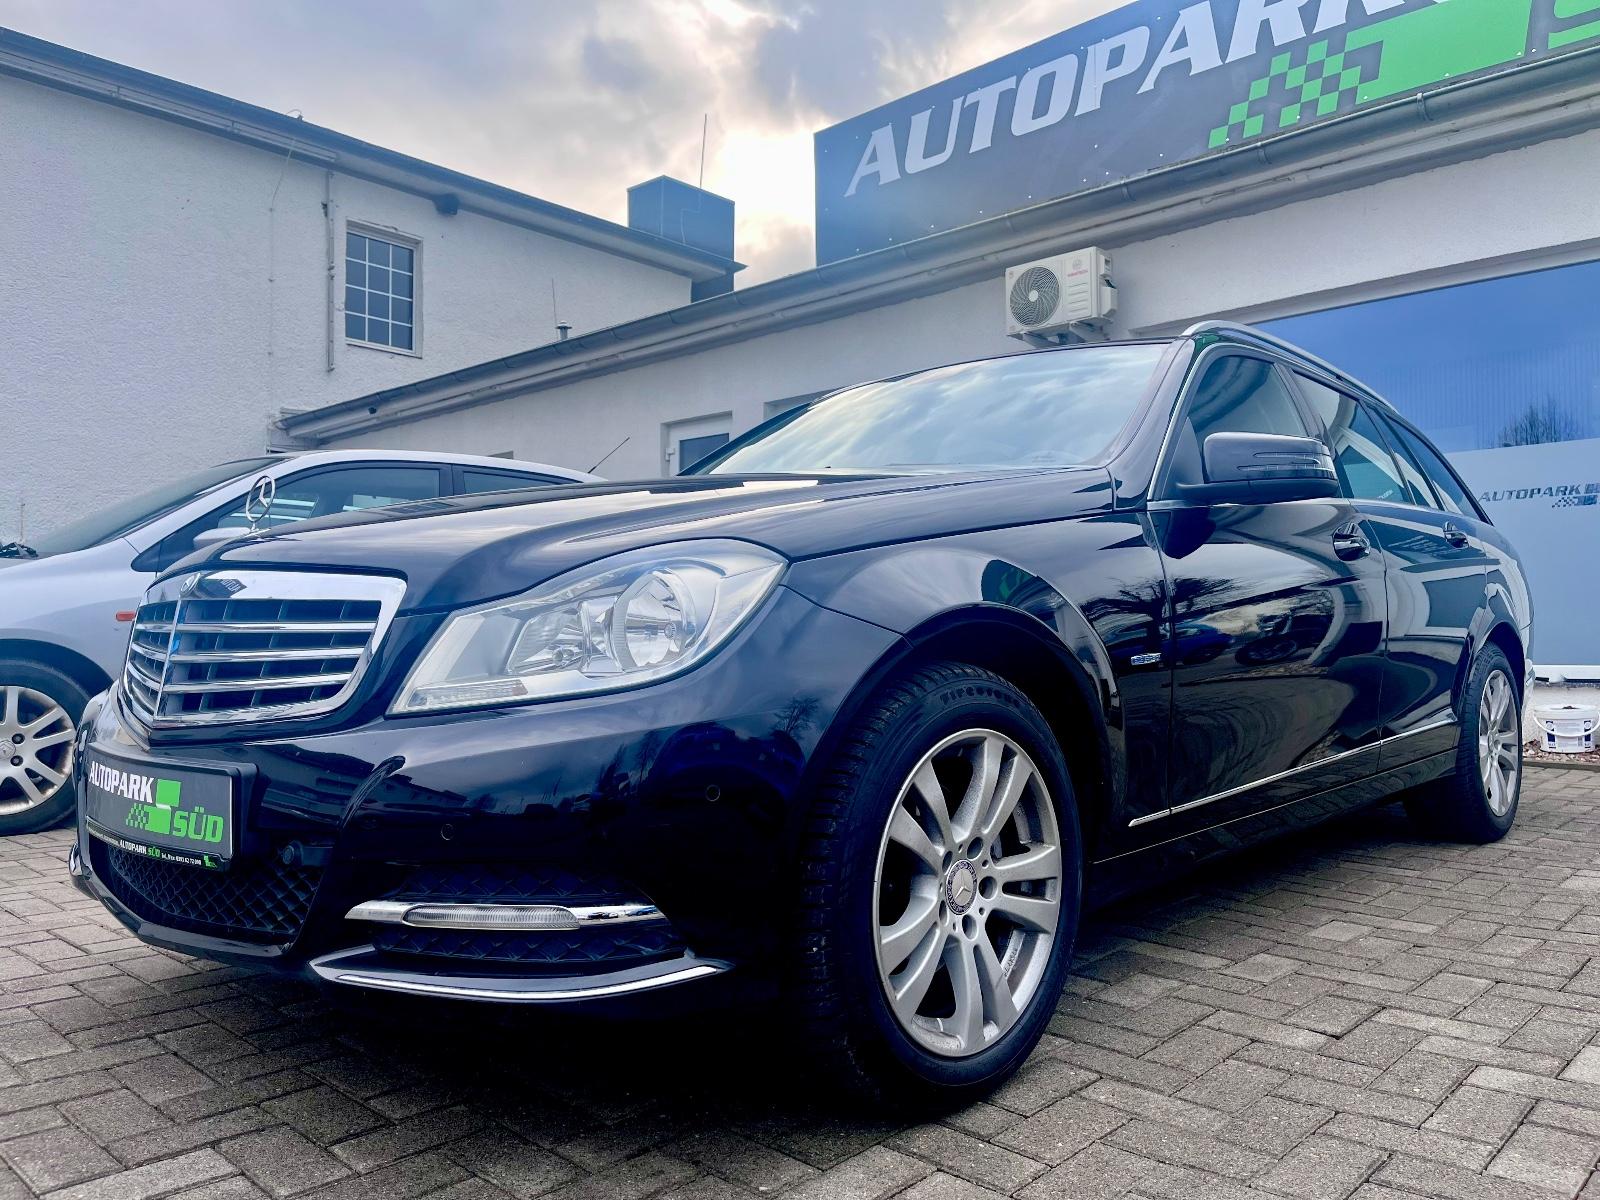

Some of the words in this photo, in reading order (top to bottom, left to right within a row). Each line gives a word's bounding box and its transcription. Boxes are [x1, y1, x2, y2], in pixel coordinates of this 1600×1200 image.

[1479, 484, 1581, 502] AUTOPARK
[89, 761, 154, 803] AUTOPARK
[173, 806, 224, 843] SÜD
[119, 840, 147, 854] AUTOPARK
[147, 846, 161, 858] SÜD
